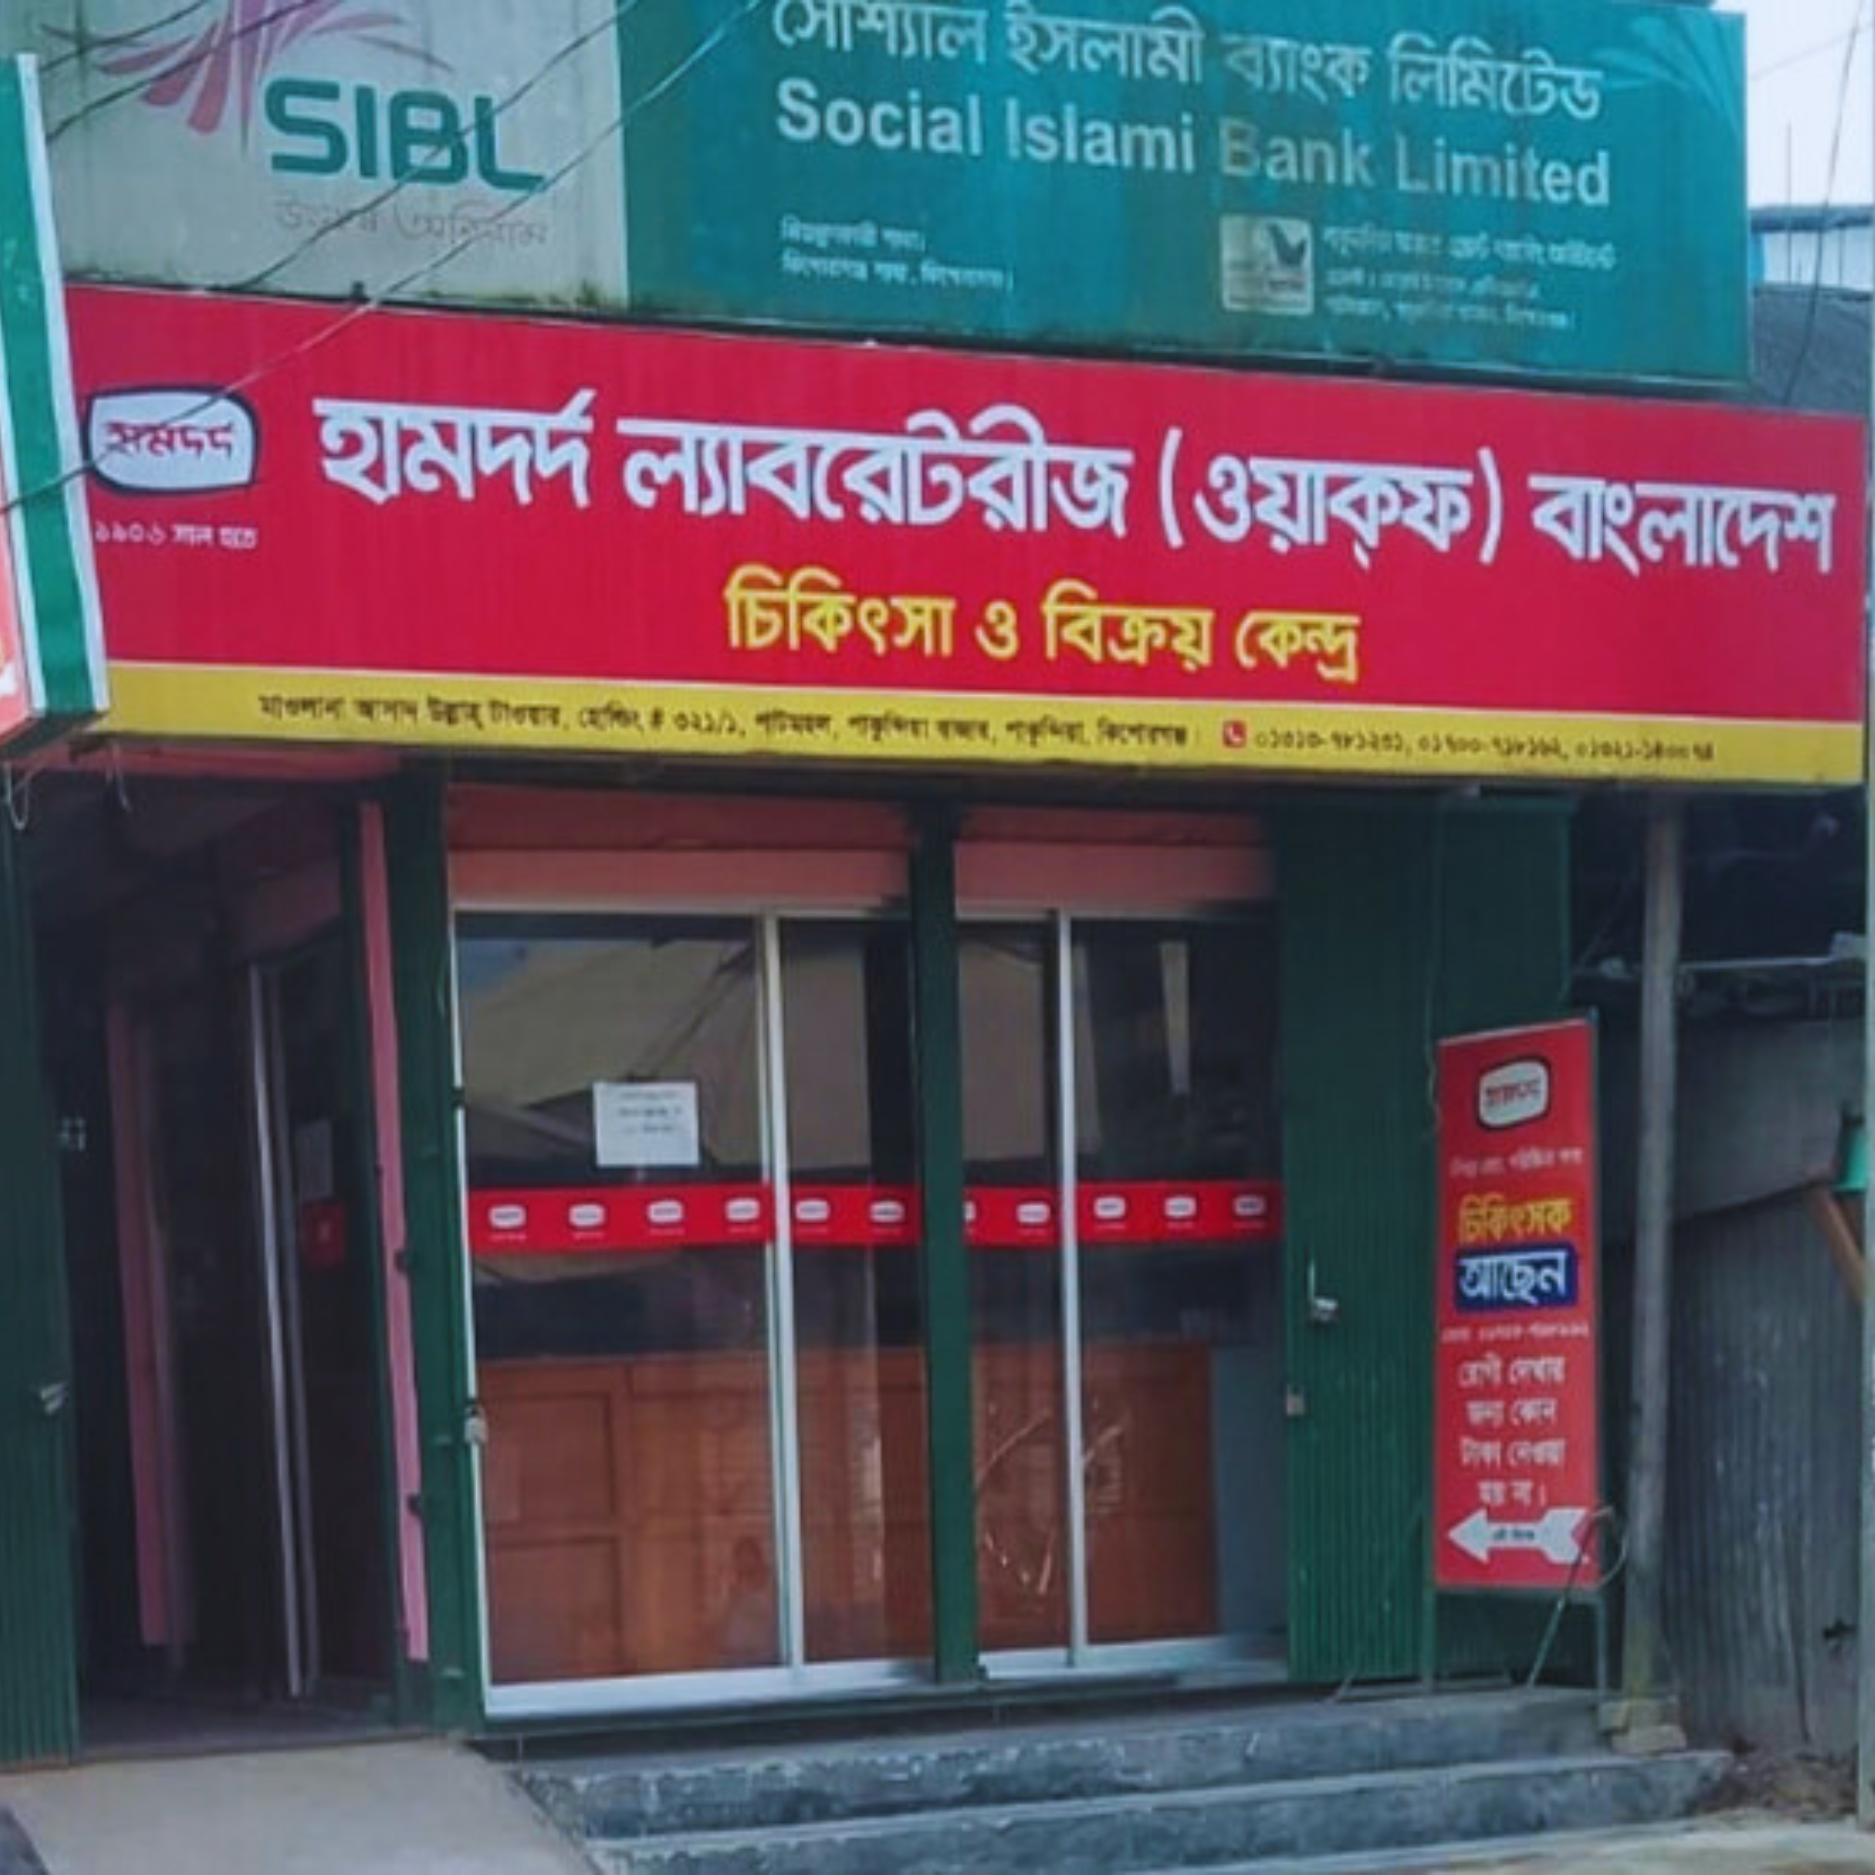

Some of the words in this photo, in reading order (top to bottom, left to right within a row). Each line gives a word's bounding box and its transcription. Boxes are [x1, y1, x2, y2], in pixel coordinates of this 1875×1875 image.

[773, 0, 988, 64] সোশ্যাল
[1004, 0, 1206, 83] ইসলামী
[1220, 32, 1372, 103] ব্যাংক
[1387, 31, 1603, 119] লিমিটেড
[264, 77, 549, 194] SIBL
[776, 77, 983, 156] Social
[1006, 98, 1197, 173] Islami
[1218, 117, 1374, 187] Bank
[1397, 132, 1611, 206] Limited
[312, 388, 596, 507] হামদর্দ
[616, 404, 1135, 537] ল্যাবরেটরীজ
[1529, 473, 1836, 577] বাংলাদেশ
[723, 563, 957, 659] চিকিৎসা
[975, 600, 1019, 660] ও
[1041, 579, 1214, 672] বিক্রয়
[1235, 608, 1363, 684] কেন্দ্র
[1458, 1192, 1573, 1245] চিকিৎসক
[1458, 1249, 1568, 1305] আছেন
